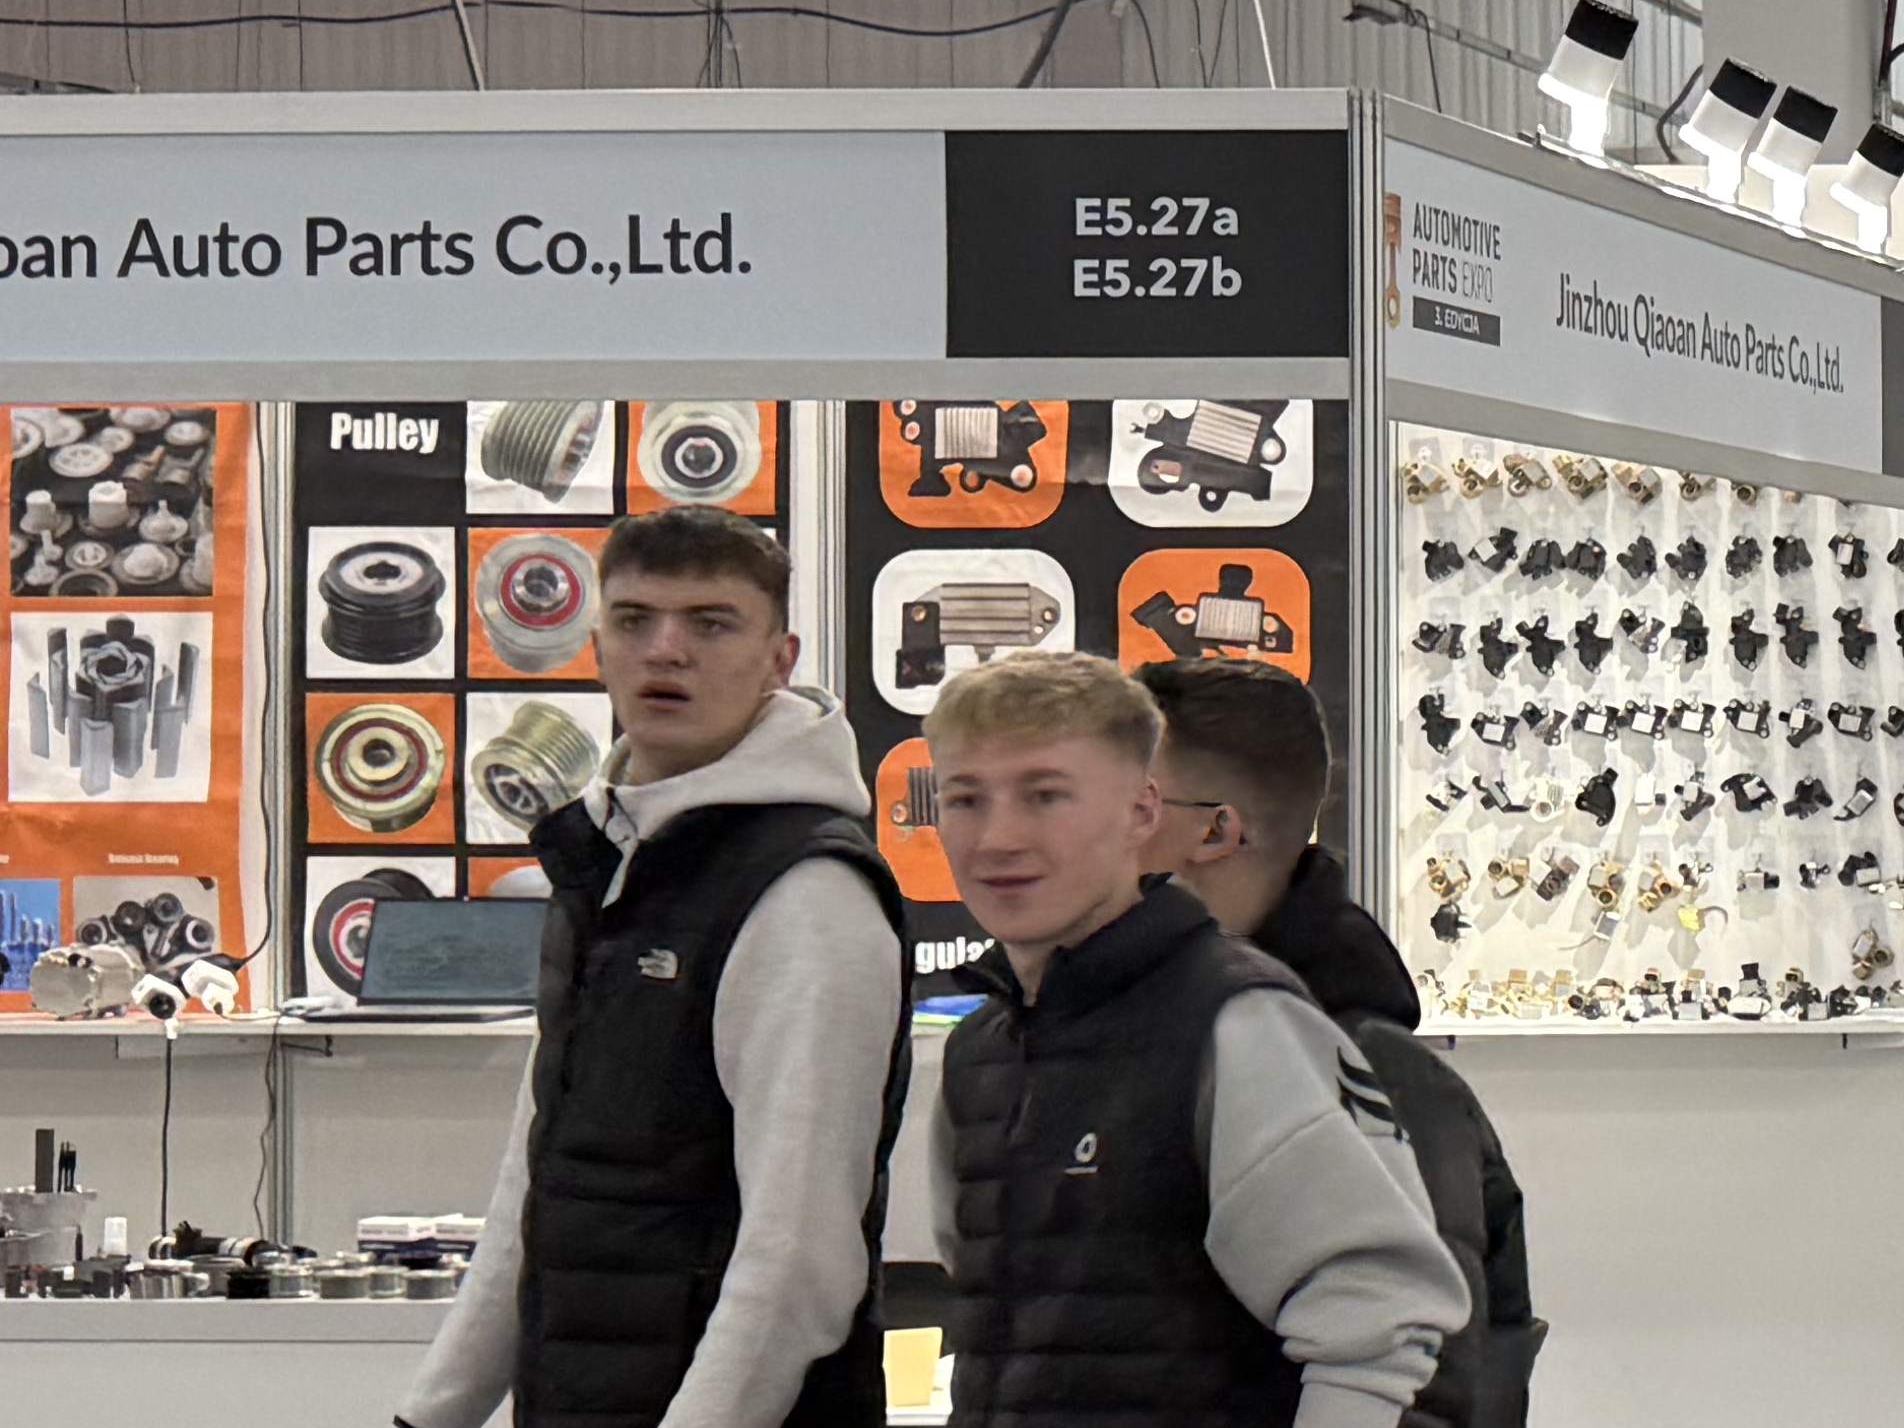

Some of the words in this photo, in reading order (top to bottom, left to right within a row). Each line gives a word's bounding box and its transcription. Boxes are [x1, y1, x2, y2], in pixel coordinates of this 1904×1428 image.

[1075, 196, 1240, 237] E5.27a
[1413, 202, 1502, 260] AUTOMOTIVE
[117, 218, 281, 279] Auto
[304, 216, 474, 277] Parts
[495, 213, 753, 286] Co.,Ltd.
[1073, 255, 1242, 298] E5.27b
[1412, 248, 1458, 293] PARTS
[1462, 259, 1493, 304] EXPO
[1556, 272, 1629, 342] Jinzhou
[1633, 293, 1697, 358] Qiaoan
[1701, 311, 1741, 369] Auto
[1745, 323, 1785, 381] Parts
[1788, 335, 1844, 395] Co.,Ltd.
[330, 412, 439, 454] Pulley
